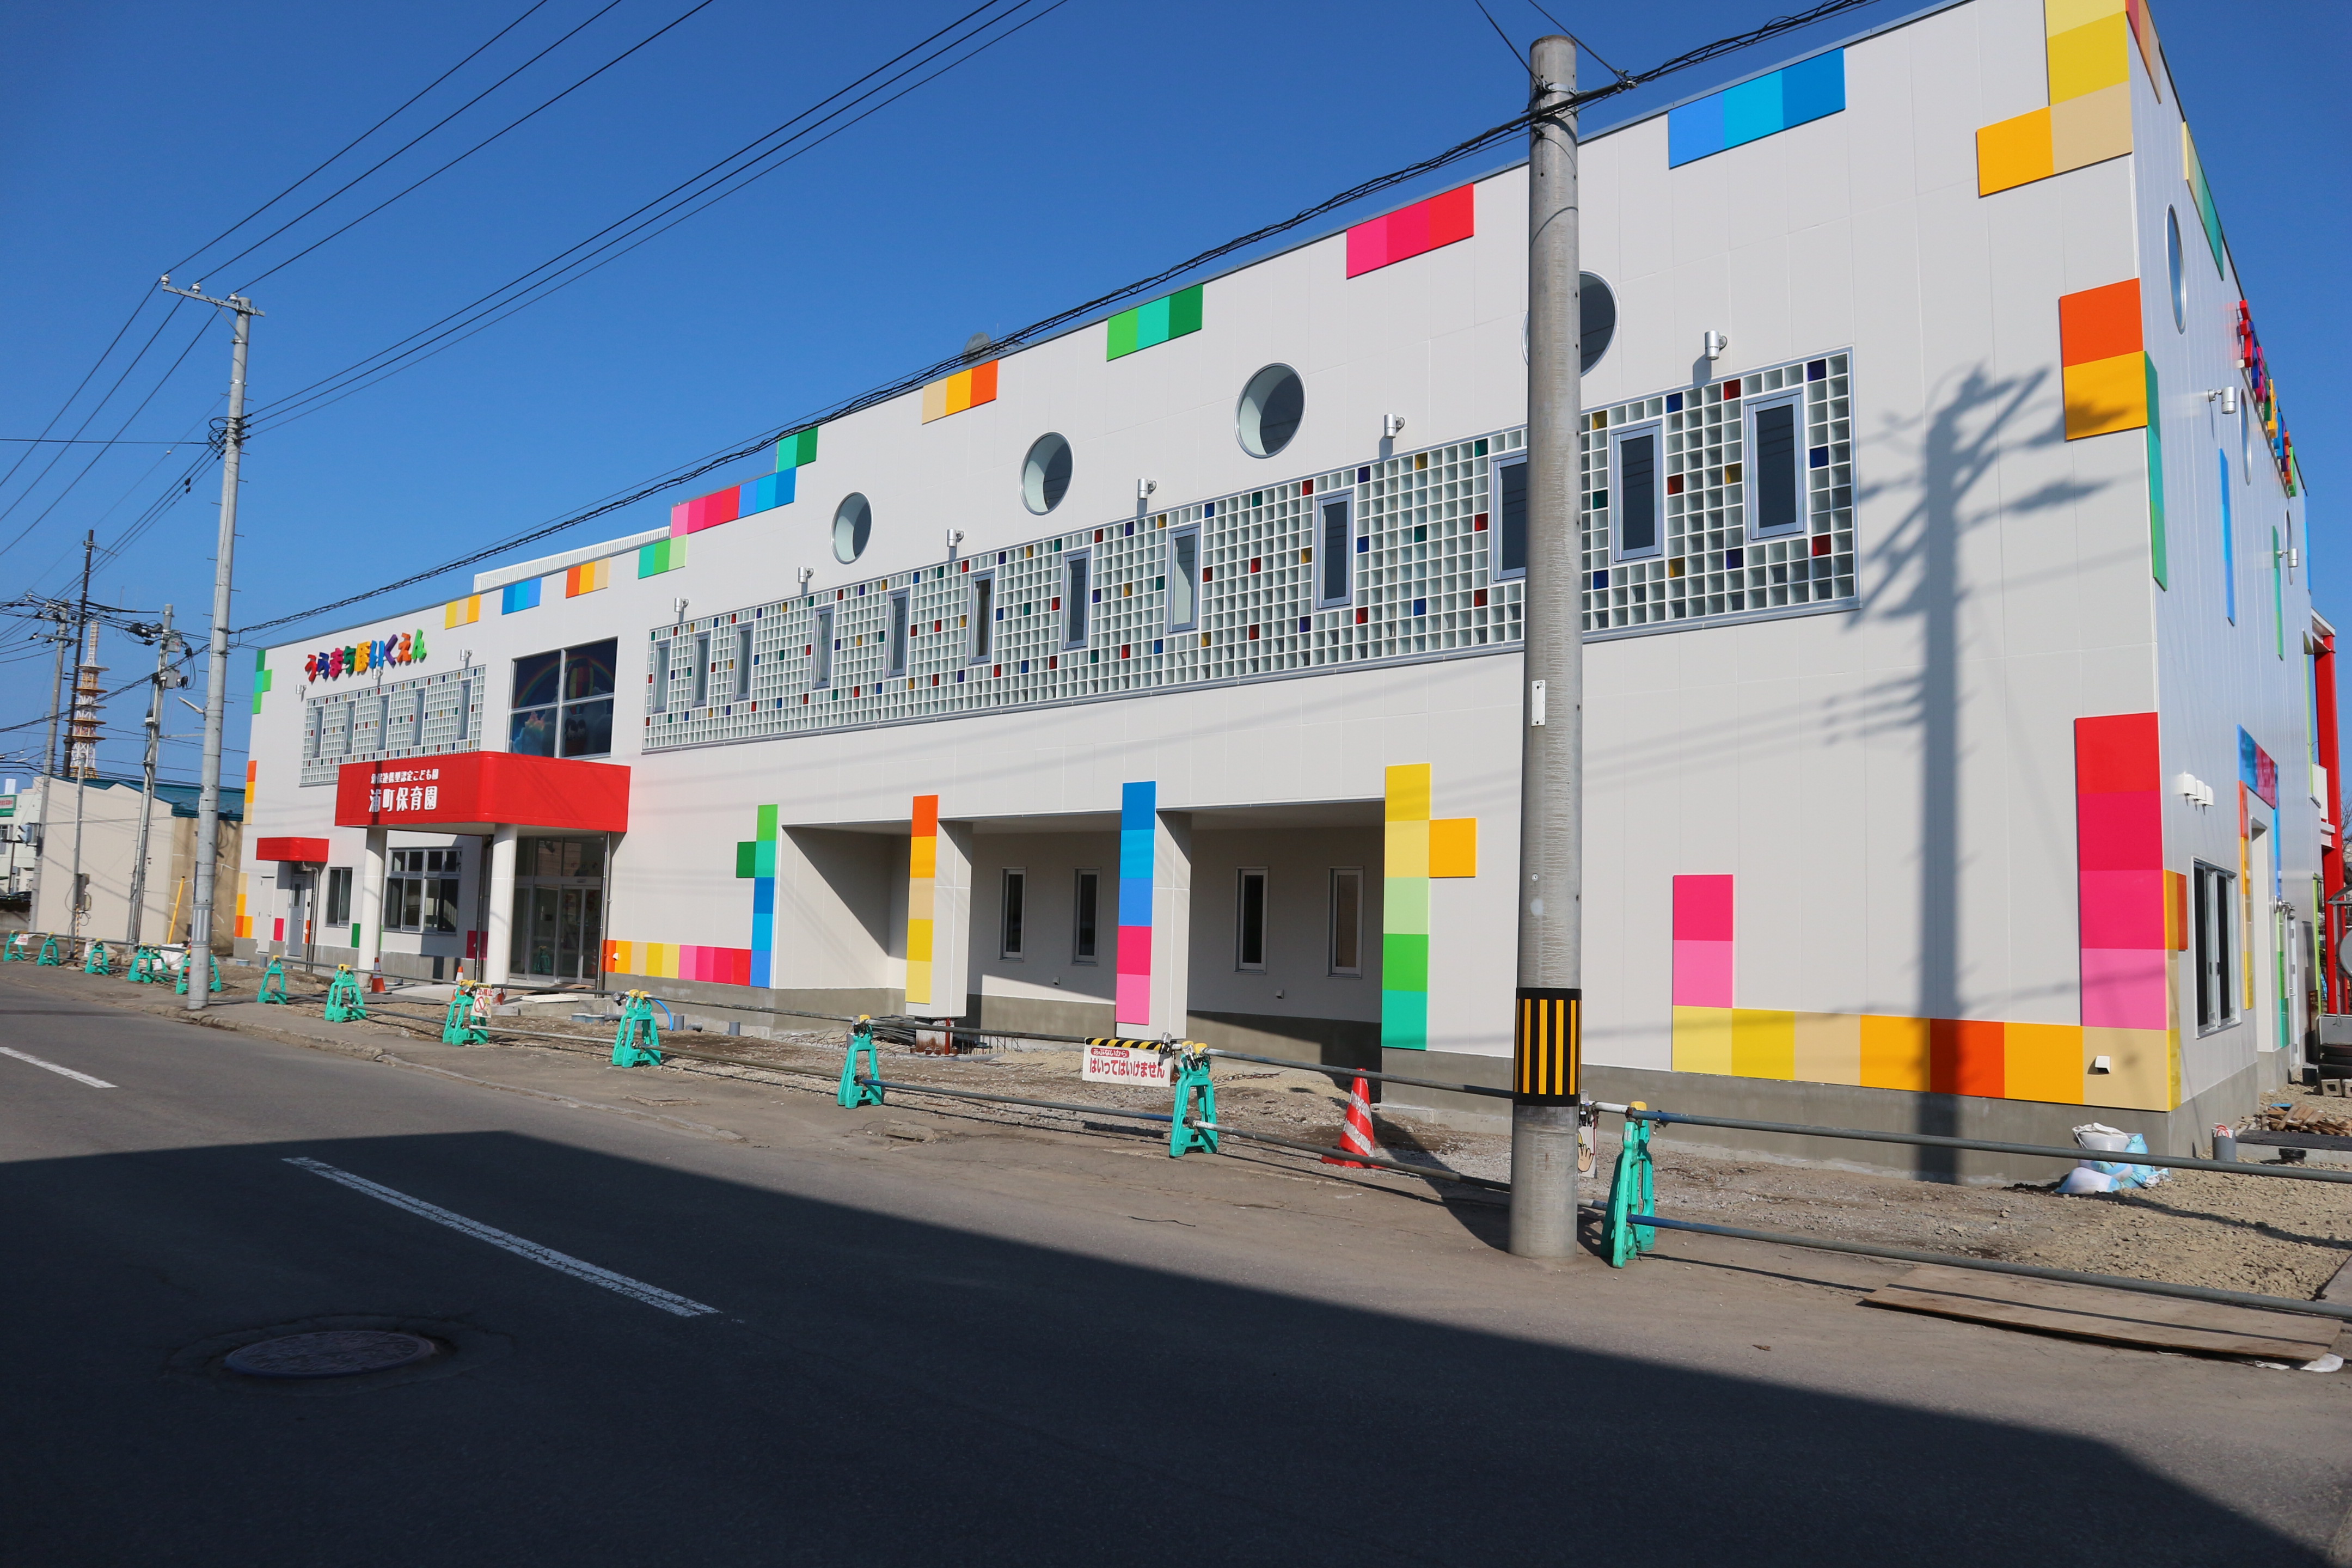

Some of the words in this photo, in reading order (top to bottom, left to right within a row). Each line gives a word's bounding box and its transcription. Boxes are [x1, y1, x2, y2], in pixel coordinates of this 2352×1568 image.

[304, 628, 427, 682] うらまちほいくえん
[369, 786, 438, 812] 浦町保育園
[1093, 1049, 1127, 1057] あぶないから
[1089, 1058, 1165, 1079] はいってはいけません
